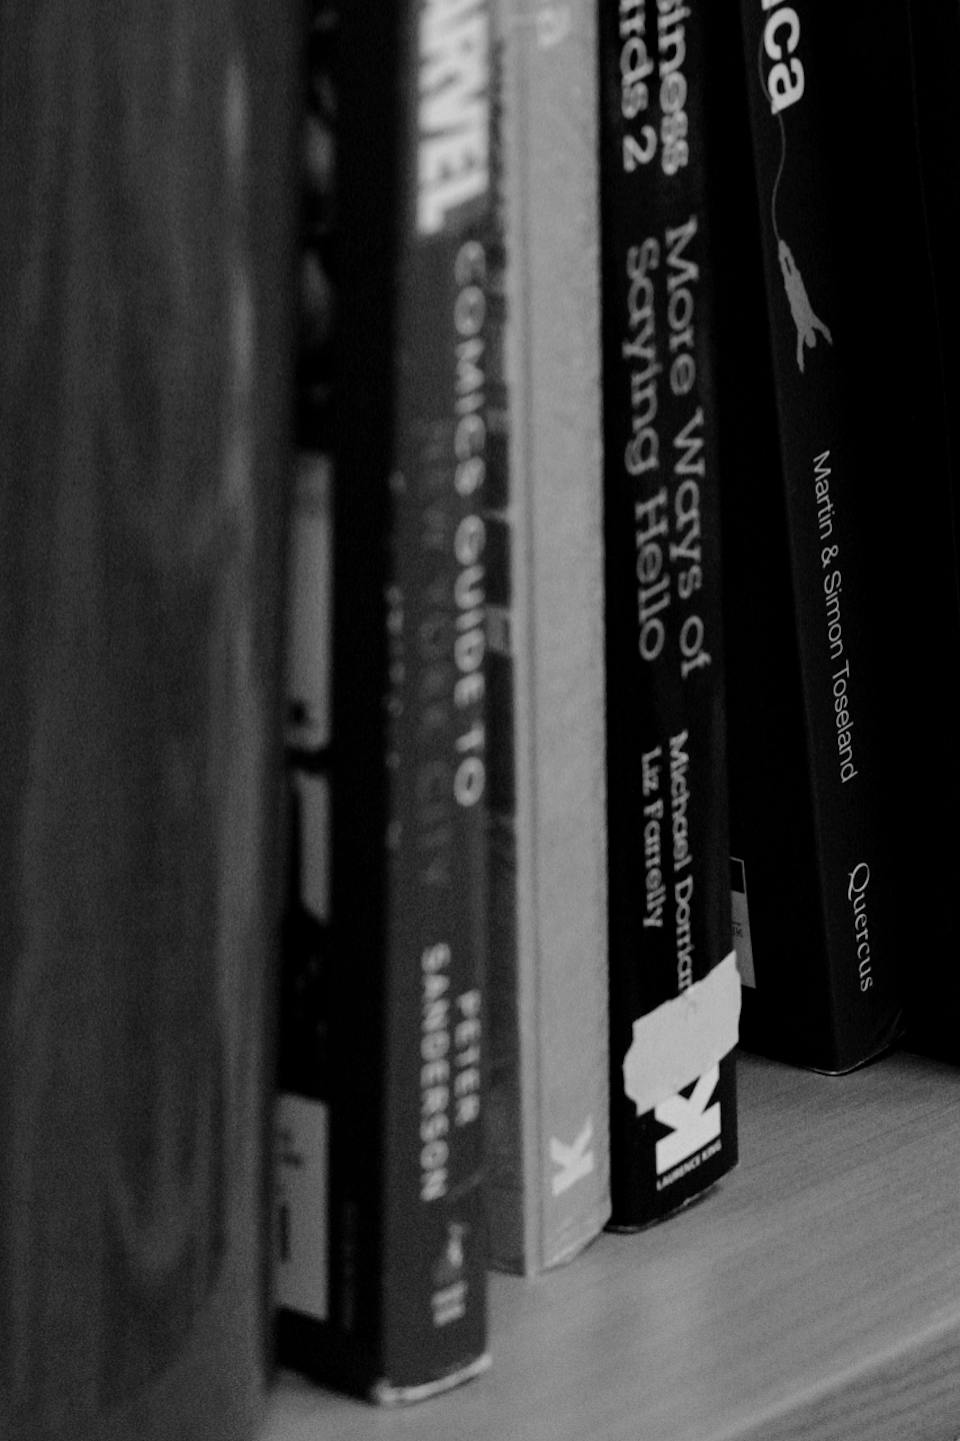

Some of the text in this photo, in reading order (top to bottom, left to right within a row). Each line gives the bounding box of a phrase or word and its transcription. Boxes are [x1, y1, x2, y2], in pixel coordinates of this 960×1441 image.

[621, 124, 658, 174] 2
[454, 240, 487, 807] COMICS GUIDE TO
[621, 236, 672, 662] Saying Hello
[665, 214, 712, 680] More Ways of
[812, 449, 858, 785] Martin & Simon Toseland
[641, 743, 663, 798] Liz
[668, 728, 694, 873] Michael
[847, 861, 873, 993] Quercus
